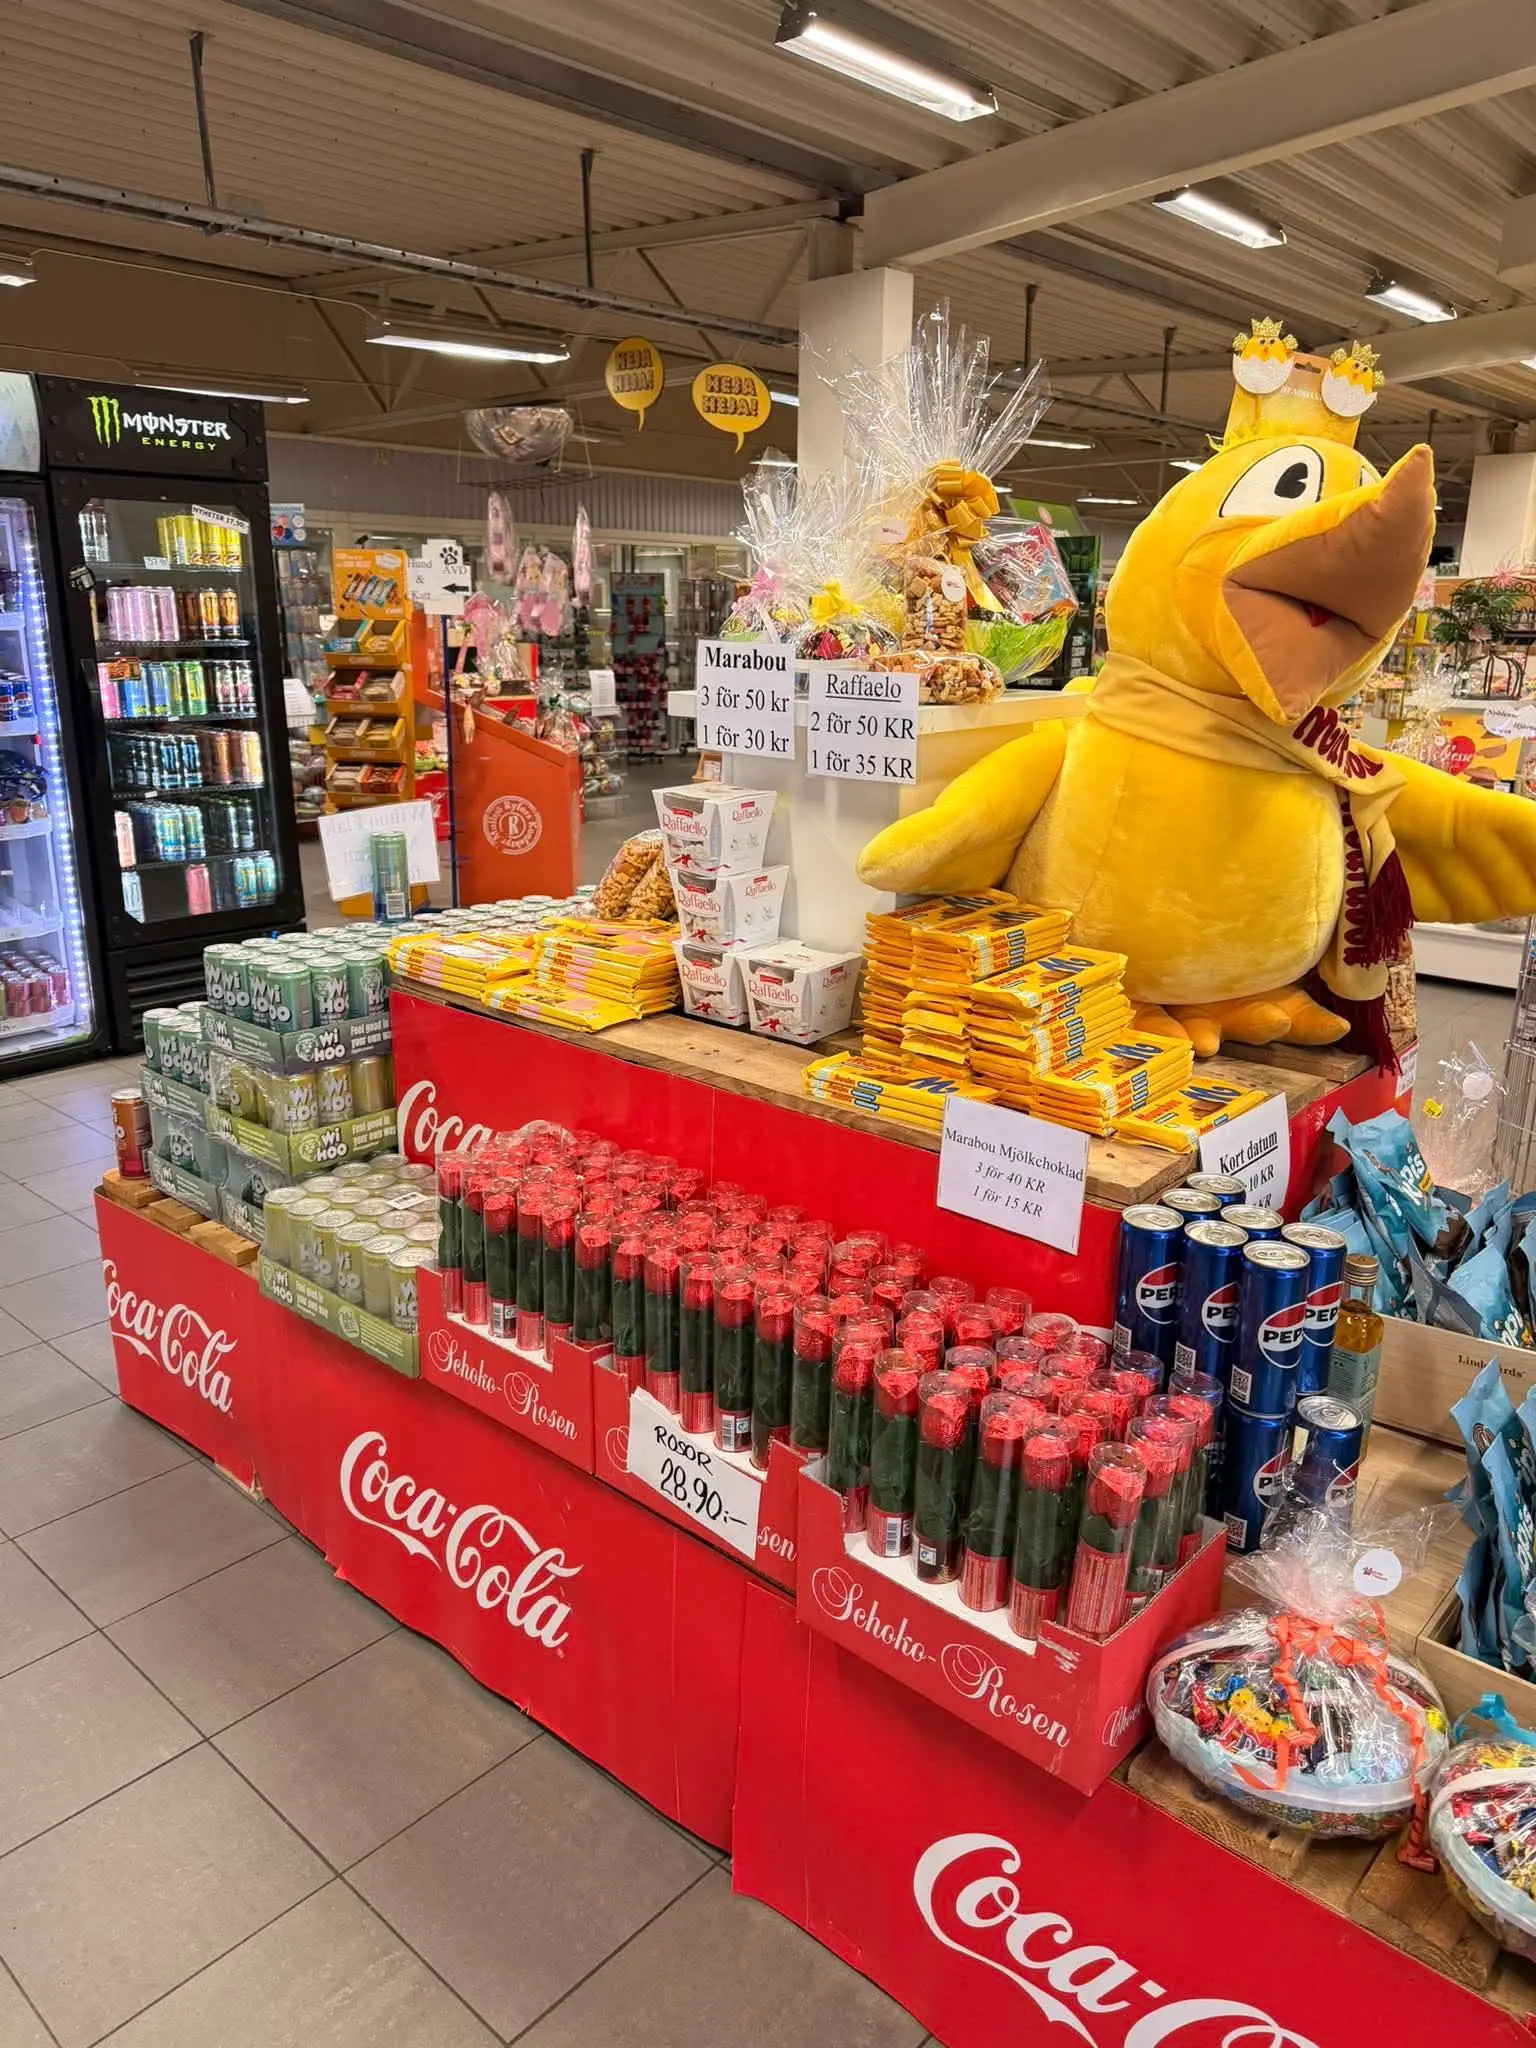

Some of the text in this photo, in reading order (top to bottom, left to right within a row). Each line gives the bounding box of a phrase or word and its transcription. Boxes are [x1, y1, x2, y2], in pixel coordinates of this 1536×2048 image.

[615, 349, 653, 370] HEJA
[613, 371, 654, 393] HEJA!
[704, 374, 757, 396] HEJA
[702, 395, 759, 416] HEJA!
[122, 411, 231, 440] MONSTER
[142, 437, 216, 450] ENERGY
[415, 575, 425, 585] &
[443, 565, 467, 575] AVD
[410, 591, 431, 601] Katt
[704, 646, 787, 672] Marabou
[827, 673, 902, 699] Raffaelo
[701, 685, 790, 713] 3 för 50 kr
[810, 711, 916, 740] 2 för 50 KR
[703, 724, 790, 753] 1 för 30 kr
[811, 749, 915, 779] 1 för 35 KR
[508, 815, 520, 836] R
[662, 814, 708, 837] Raffaello
[732, 807, 763, 822] Raffaello
[745, 882, 777, 897] Raffaello
[678, 890, 721, 913] Raffaello
[682, 964, 727, 988] Raffaello
[224, 991, 250, 1007] OO
[748, 979, 799, 1004] Raffaello
[319, 1028, 339, 1047] Wi
[314, 1044, 346, 1063] HOO
[321, 1127, 341, 1146] Wi
[316, 1142, 348, 1163] HOO
[945, 1127, 1084, 1182] Marabou Mjölkchoklad
[1219, 1131, 1279, 1175] Kort datum
[974, 1161, 1046, 1194] 3 för 40 KR
[1260, 1163, 1275, 1185] KR
[973, 1185, 1043, 1218] 1 för 15 KR
[275, 1268, 288, 1287] Wi
[272, 1281, 293, 1303] HOO
[428, 1329, 578, 1440] Schoko-Rosen
[654, 1425, 714, 1476] ROSOR
[660, 1457, 748, 1521] 28.90:-
[339, 1430, 585, 1649] Coca-Cola
[757, 1526, 797, 1562] sen
[810, 1566, 1070, 1748] Schoko-Rosen
[912, 1832, 1320, 2048] Coca-
